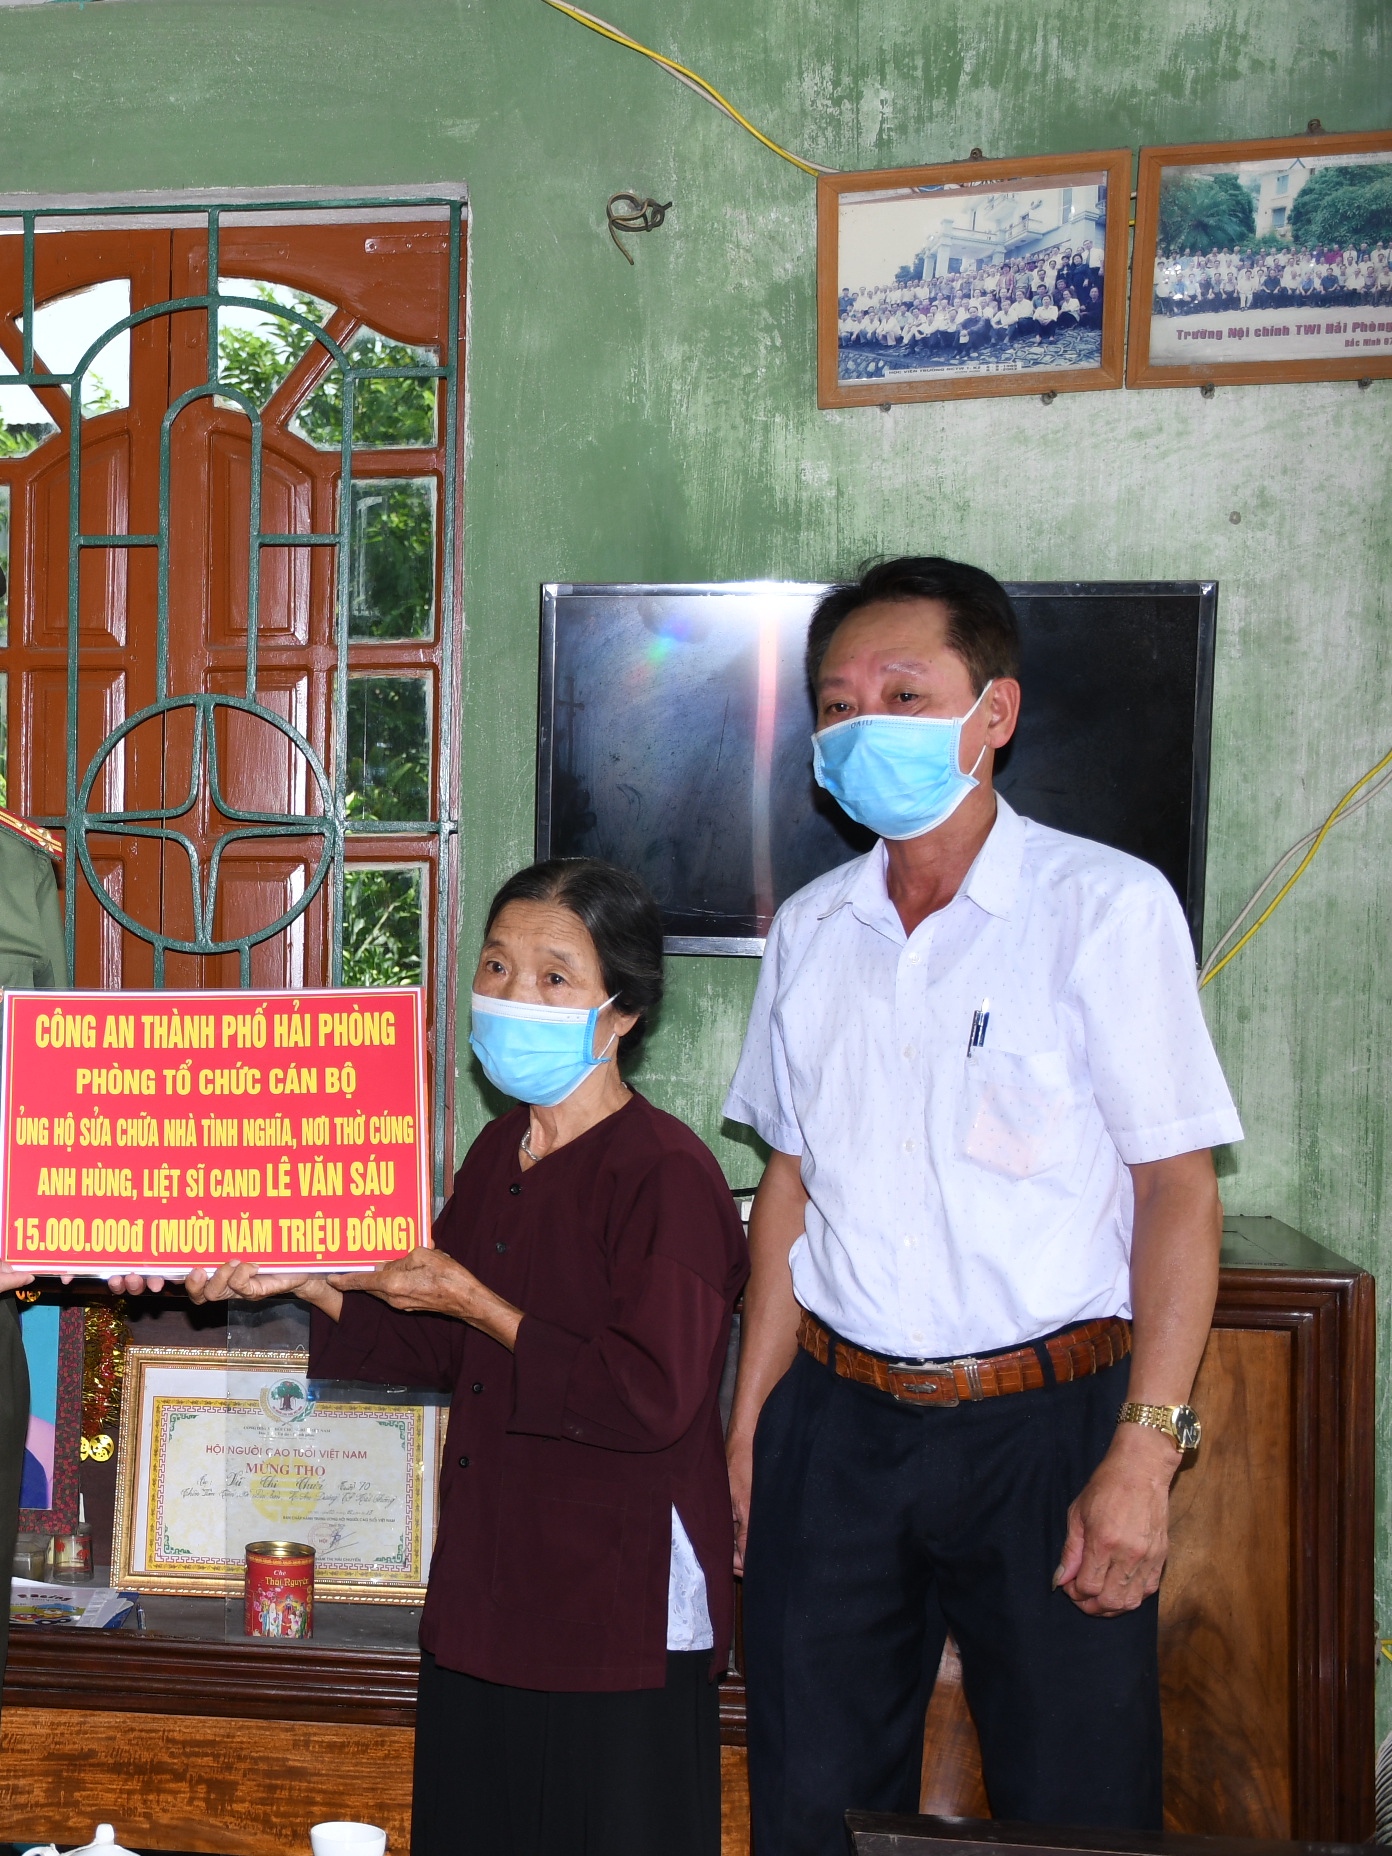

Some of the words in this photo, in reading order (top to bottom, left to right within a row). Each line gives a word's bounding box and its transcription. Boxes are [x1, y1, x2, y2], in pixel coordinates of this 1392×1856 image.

[35, 1007, 96, 1048] CÔNG
[103, 1015, 134, 1048] AN
[141, 1008, 214, 1048] THÀNH
[222, 1002, 267, 1048] PHỐ
[274, 999, 310, 1047] HẢI
[318, 1004, 395, 1046] PHÒNG
[76, 1062, 155, 1094] PHÒNG
[163, 1059, 192, 1095] TỔ
[199, 1061, 261, 1095] CHỨC
[269, 1062, 317, 1094] CÁN
[325, 1061, 356, 1098] BỘ
[53, 1111, 75, 1151] HỘ
[79, 1106, 111, 1146] SỬA
[116, 1111, 159, 1146] CHỮA
[163, 1113, 197, 1146] NHÀ
[201, 1113, 237, 1146] TÌNH
[243, 1112, 296, 1148] NGHĨA,
[301, 1115, 329, 1145] NƠI
[333, 1109, 365, 1144] THỜ
[369, 1110, 413, 1144] CÚNG
[37, 1167, 76, 1195] ANH
[81, 1162, 137, 1200] HÙNG,
[143, 1163, 180, 1203] LIỆT
[185, 1163, 205, 1197] SĨ
[210, 1168, 260, 1197] CAND
[266, 1155, 291, 1196] LÊ
[298, 1155, 342, 1196] VĂN
[350, 1154, 394, 1195] SÁU
[14, 1217, 144, 1252] 15.000.000đ
[151, 1210, 214, 1256] (MƯỜI
[222, 1212, 272, 1252] NĂM
[278, 1211, 340, 1259] TRIỆU
[346, 1205, 415, 1252] ĐỒNG)
[206, 1444, 225, 1454] HỘI
[319, 1448, 340, 1461] VIỆT
[343, 1450, 367, 1459] NAM
